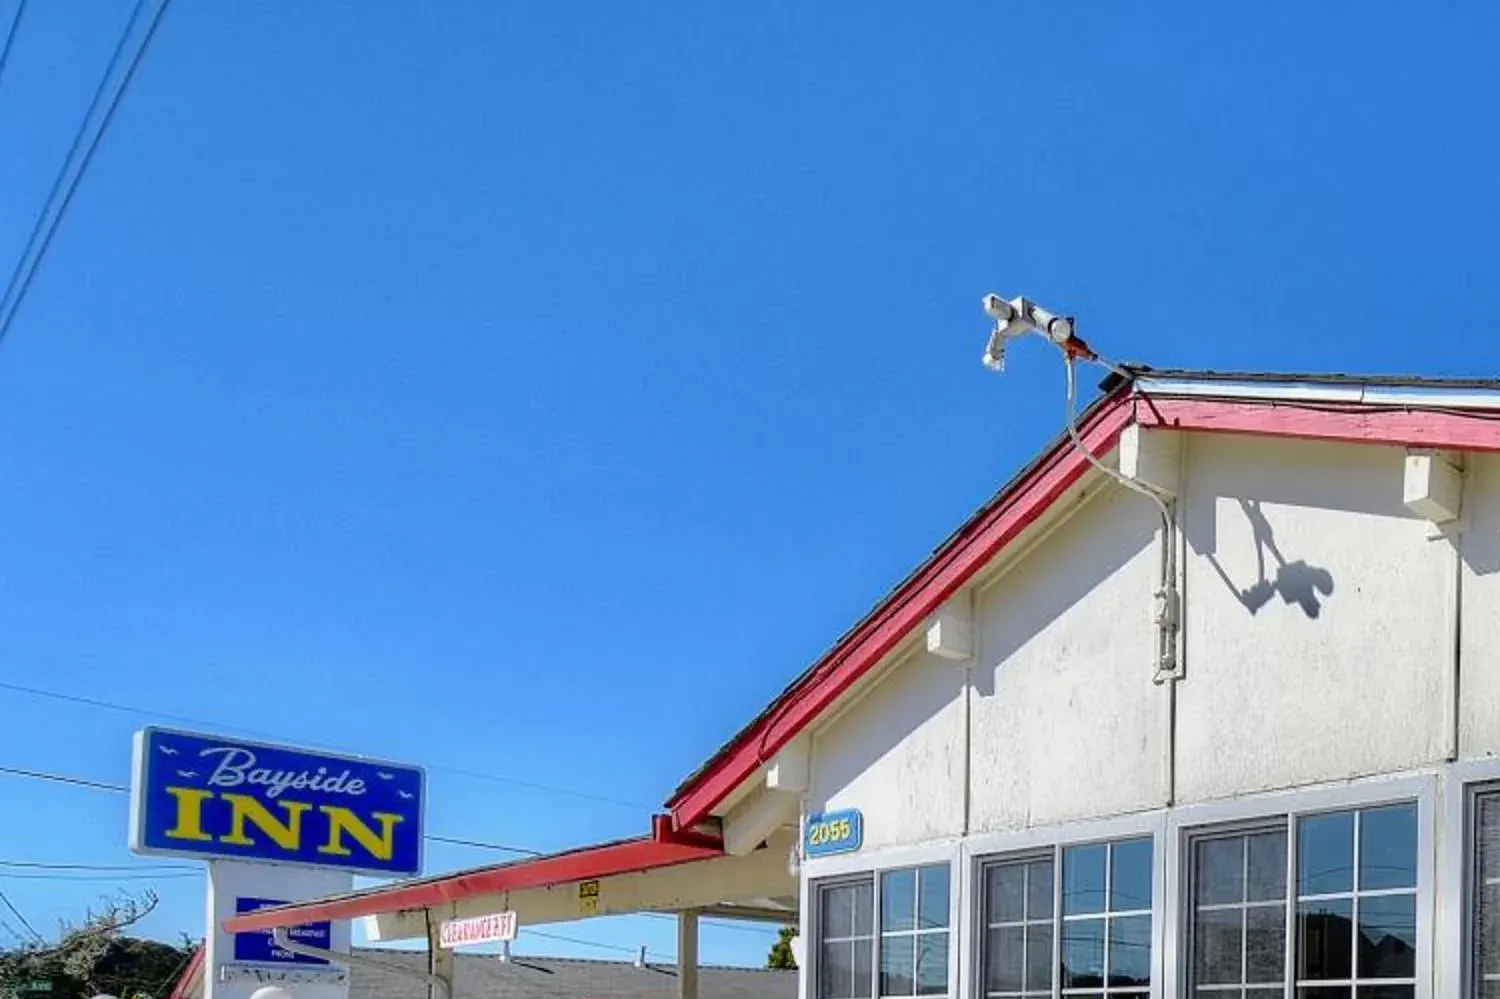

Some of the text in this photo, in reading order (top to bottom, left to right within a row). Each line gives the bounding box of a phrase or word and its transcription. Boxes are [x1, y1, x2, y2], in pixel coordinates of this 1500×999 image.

[199, 746, 367, 799] Bayside
[165, 786, 405, 861] INN
[808, 819, 850, 846] 2055
